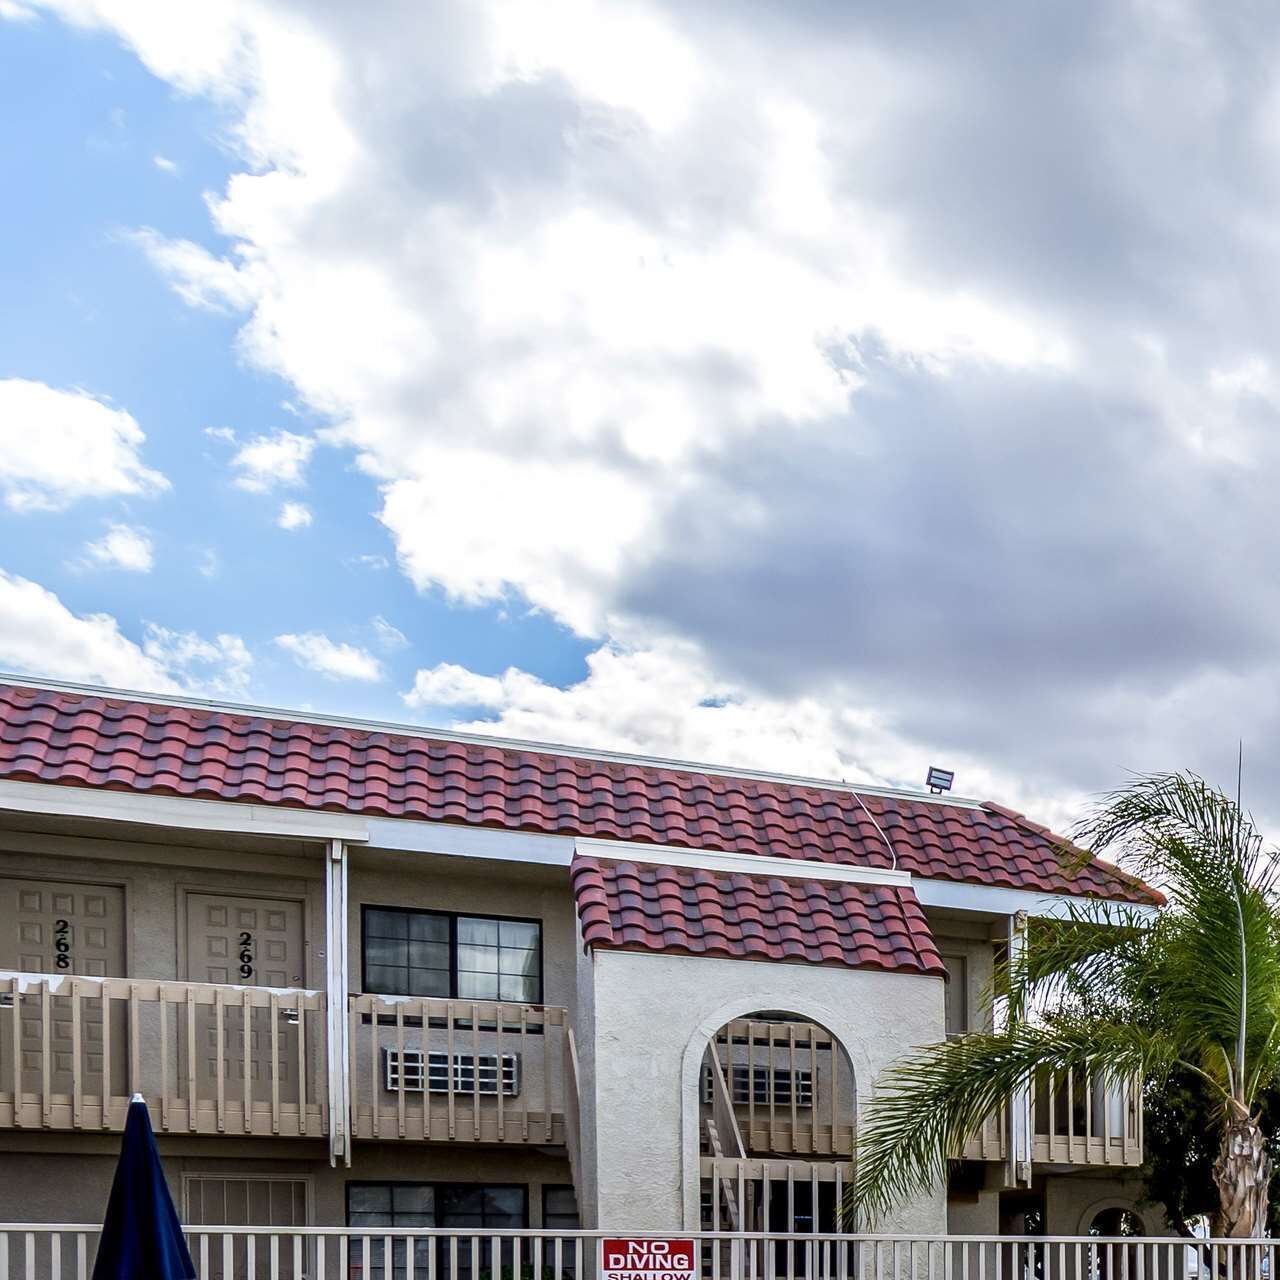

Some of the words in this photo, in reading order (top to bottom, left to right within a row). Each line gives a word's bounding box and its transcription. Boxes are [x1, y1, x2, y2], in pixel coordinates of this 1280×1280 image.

[55, 919, 70, 969] 268
[240, 932, 253, 979] 269
[609, 1253, 689, 1270] DIVING
[628, 1241, 669, 1254] NO
